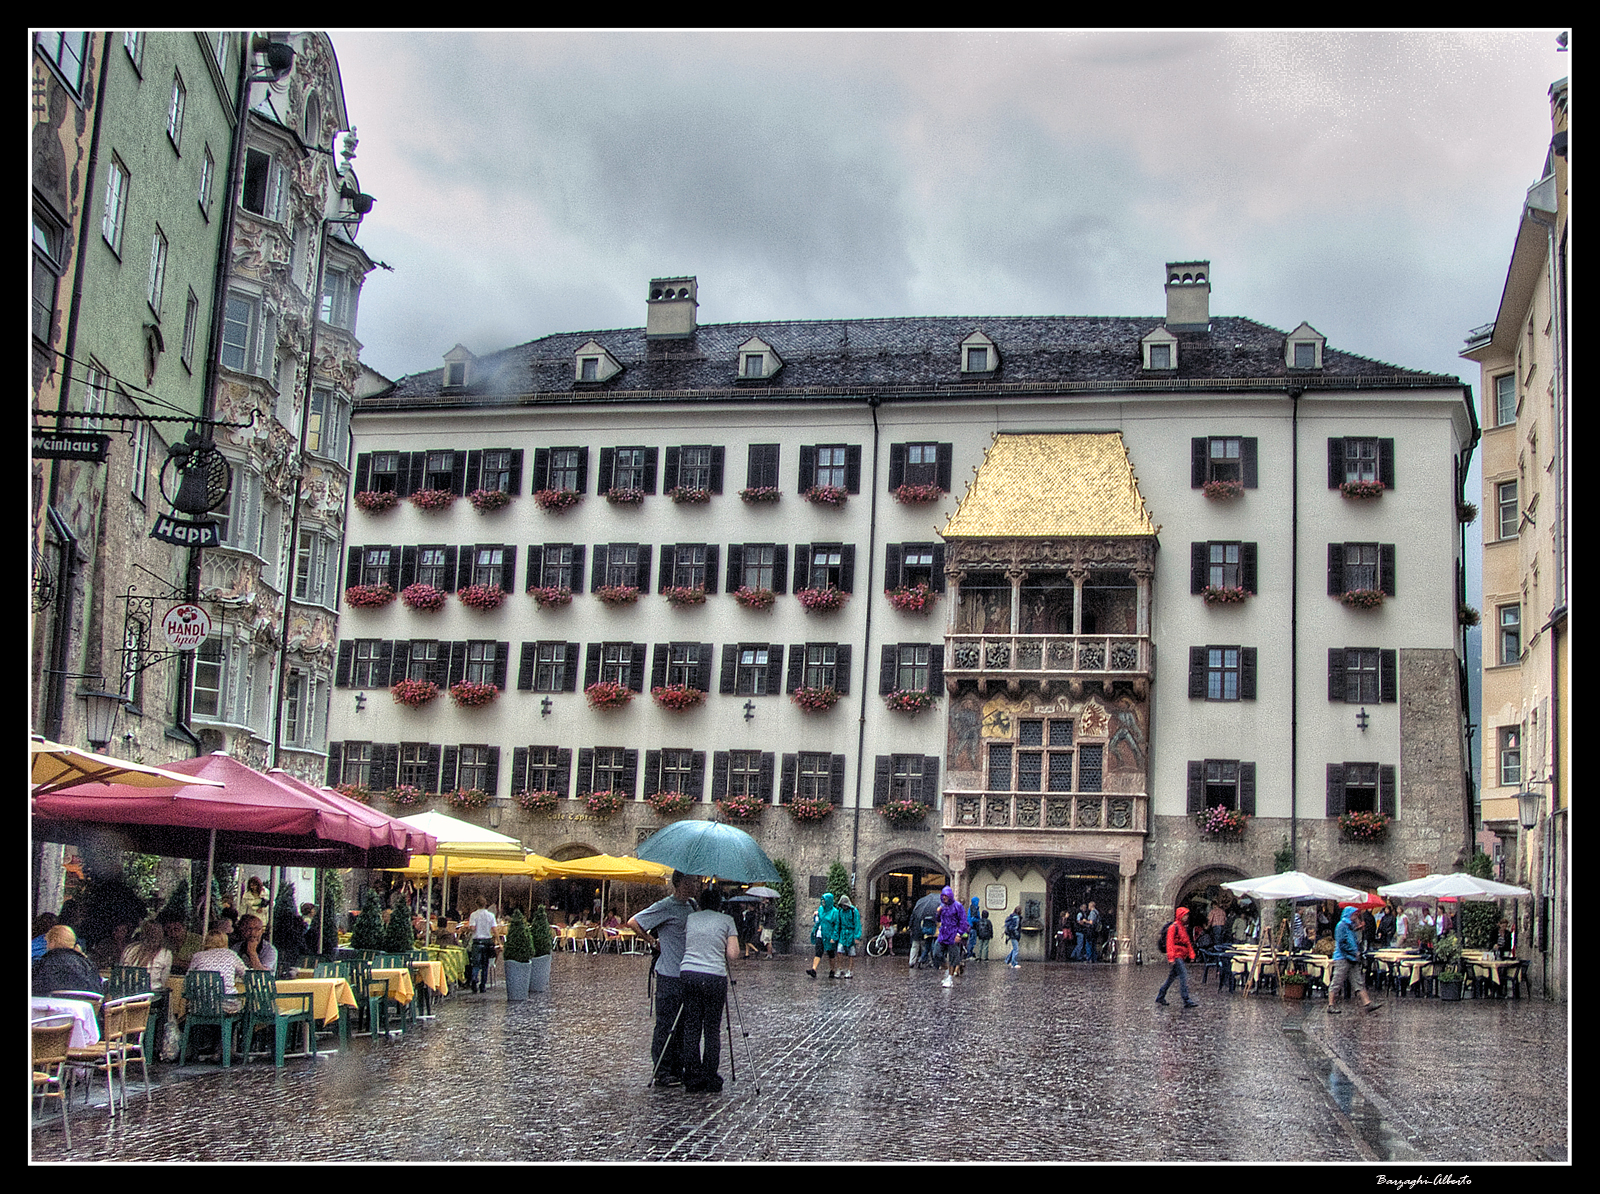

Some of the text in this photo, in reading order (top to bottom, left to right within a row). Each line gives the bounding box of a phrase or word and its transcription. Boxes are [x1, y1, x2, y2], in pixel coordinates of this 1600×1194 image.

[32, 435, 99, 452] Weinhaus
[158, 519, 212, 543] Happ
[168, 621, 206, 636] HANDL
[169, 632, 200, 647] Tyrol
